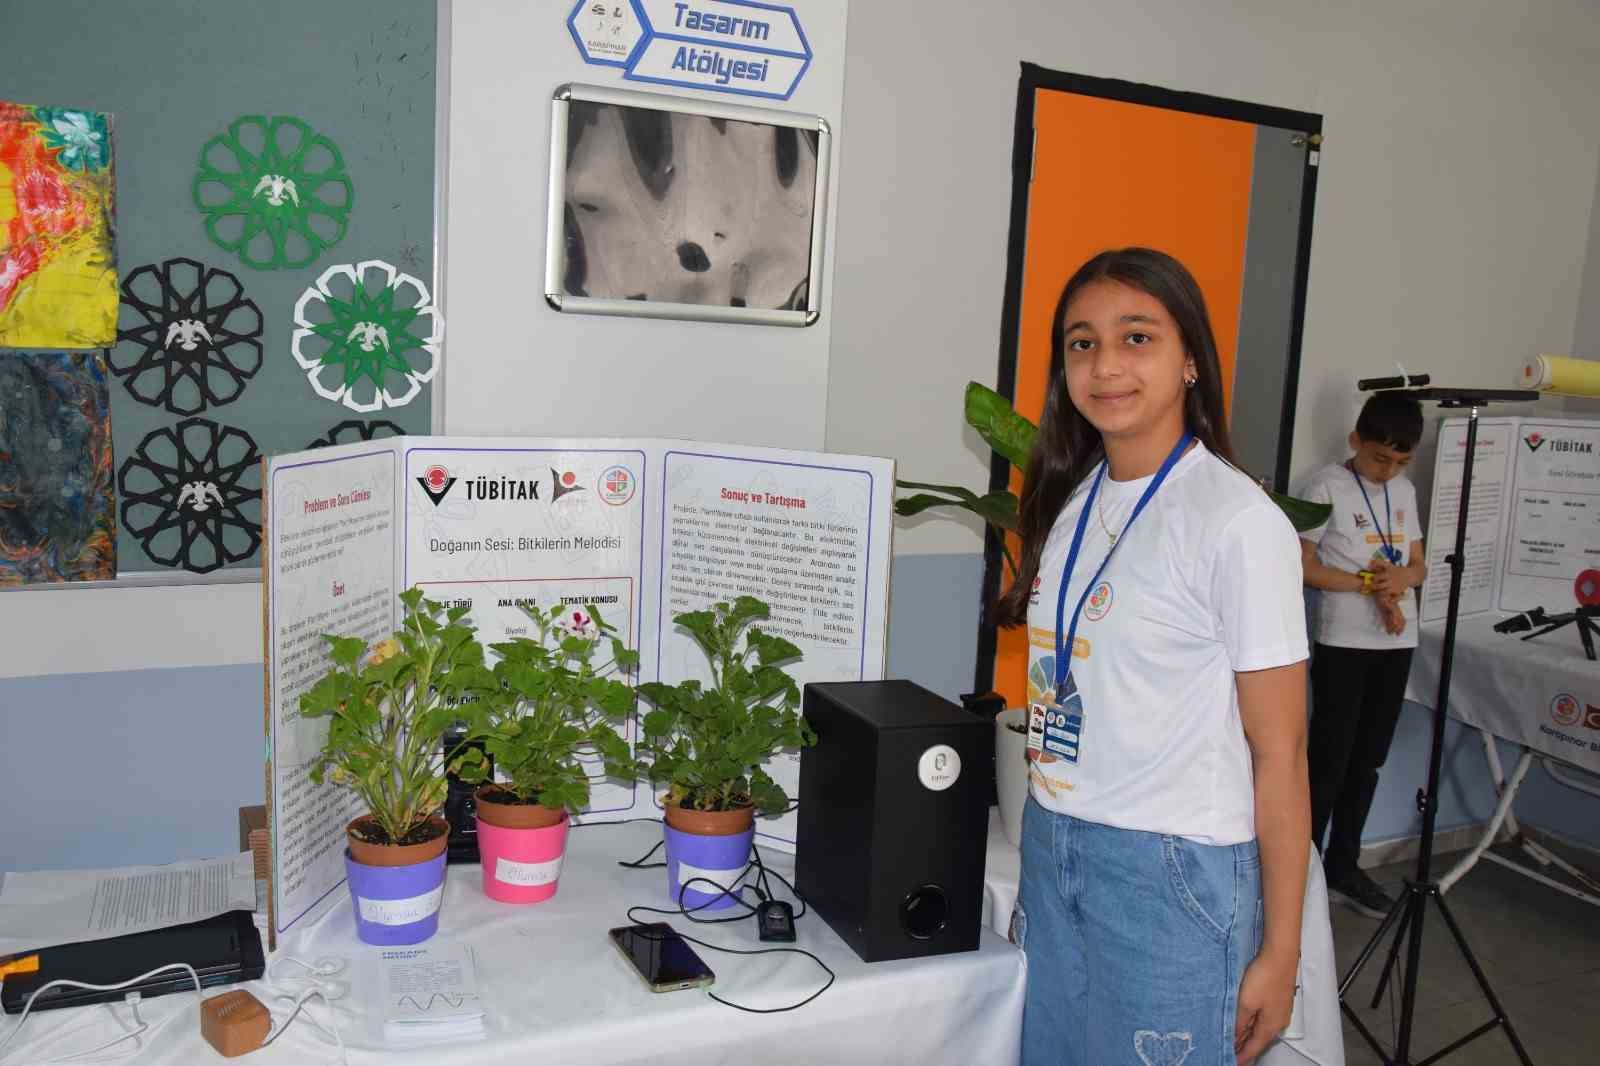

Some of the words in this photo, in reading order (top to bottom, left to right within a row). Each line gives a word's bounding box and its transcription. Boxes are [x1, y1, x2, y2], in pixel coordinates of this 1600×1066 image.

[674, 3, 770, 40] Tasarım
[672, 46, 769, 84] Atölyesi
[1550, 440, 1592, 454] TÜBİTAK
[466, 476, 539, 500] TÜBİTAK
[720, 488, 748, 504] Sonuç
[752, 494, 762, 504] ve
[765, 492, 806, 509] Tartışma
[430, 538, 481, 554] Doğanın
[484, 538, 514, 552] Sesi:
[518, 538, 570, 550] Bitkilerin
[574, 536, 621, 550] Melodisi
[804, 532, 814, 541] Bu
[454, 598, 472, 608] TÜRÜ
[560, 594, 588, 605] TEMATİK
[591, 595, 618, 604] KONUSU
